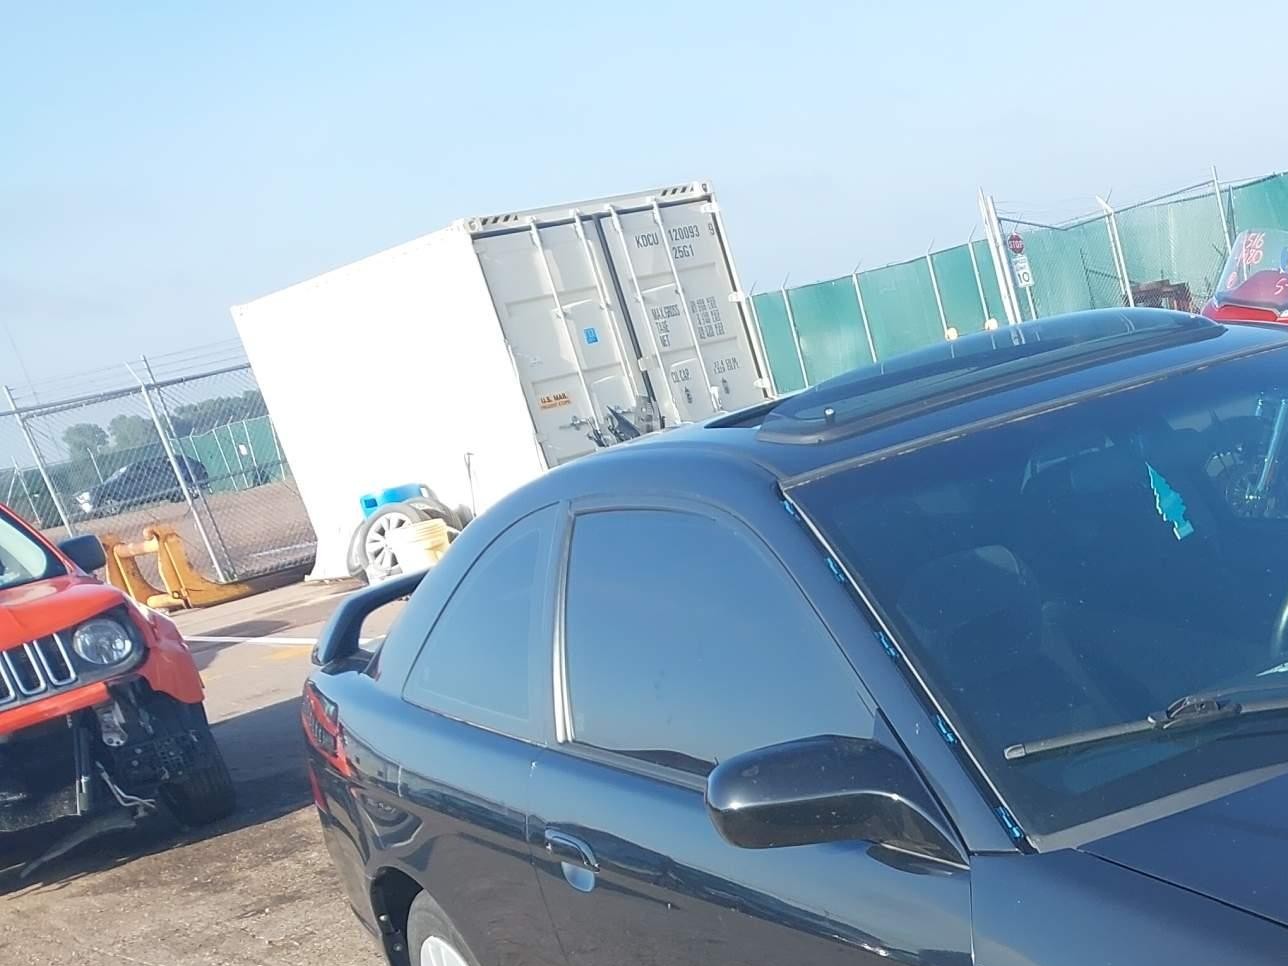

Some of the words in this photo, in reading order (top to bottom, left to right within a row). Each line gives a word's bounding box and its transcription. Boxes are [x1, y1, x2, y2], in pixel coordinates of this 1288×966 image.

[668, 224, 700, 241] 120093
[672, 243, 695, 259] 25G1
[1017, 271, 1030, 284] 10
